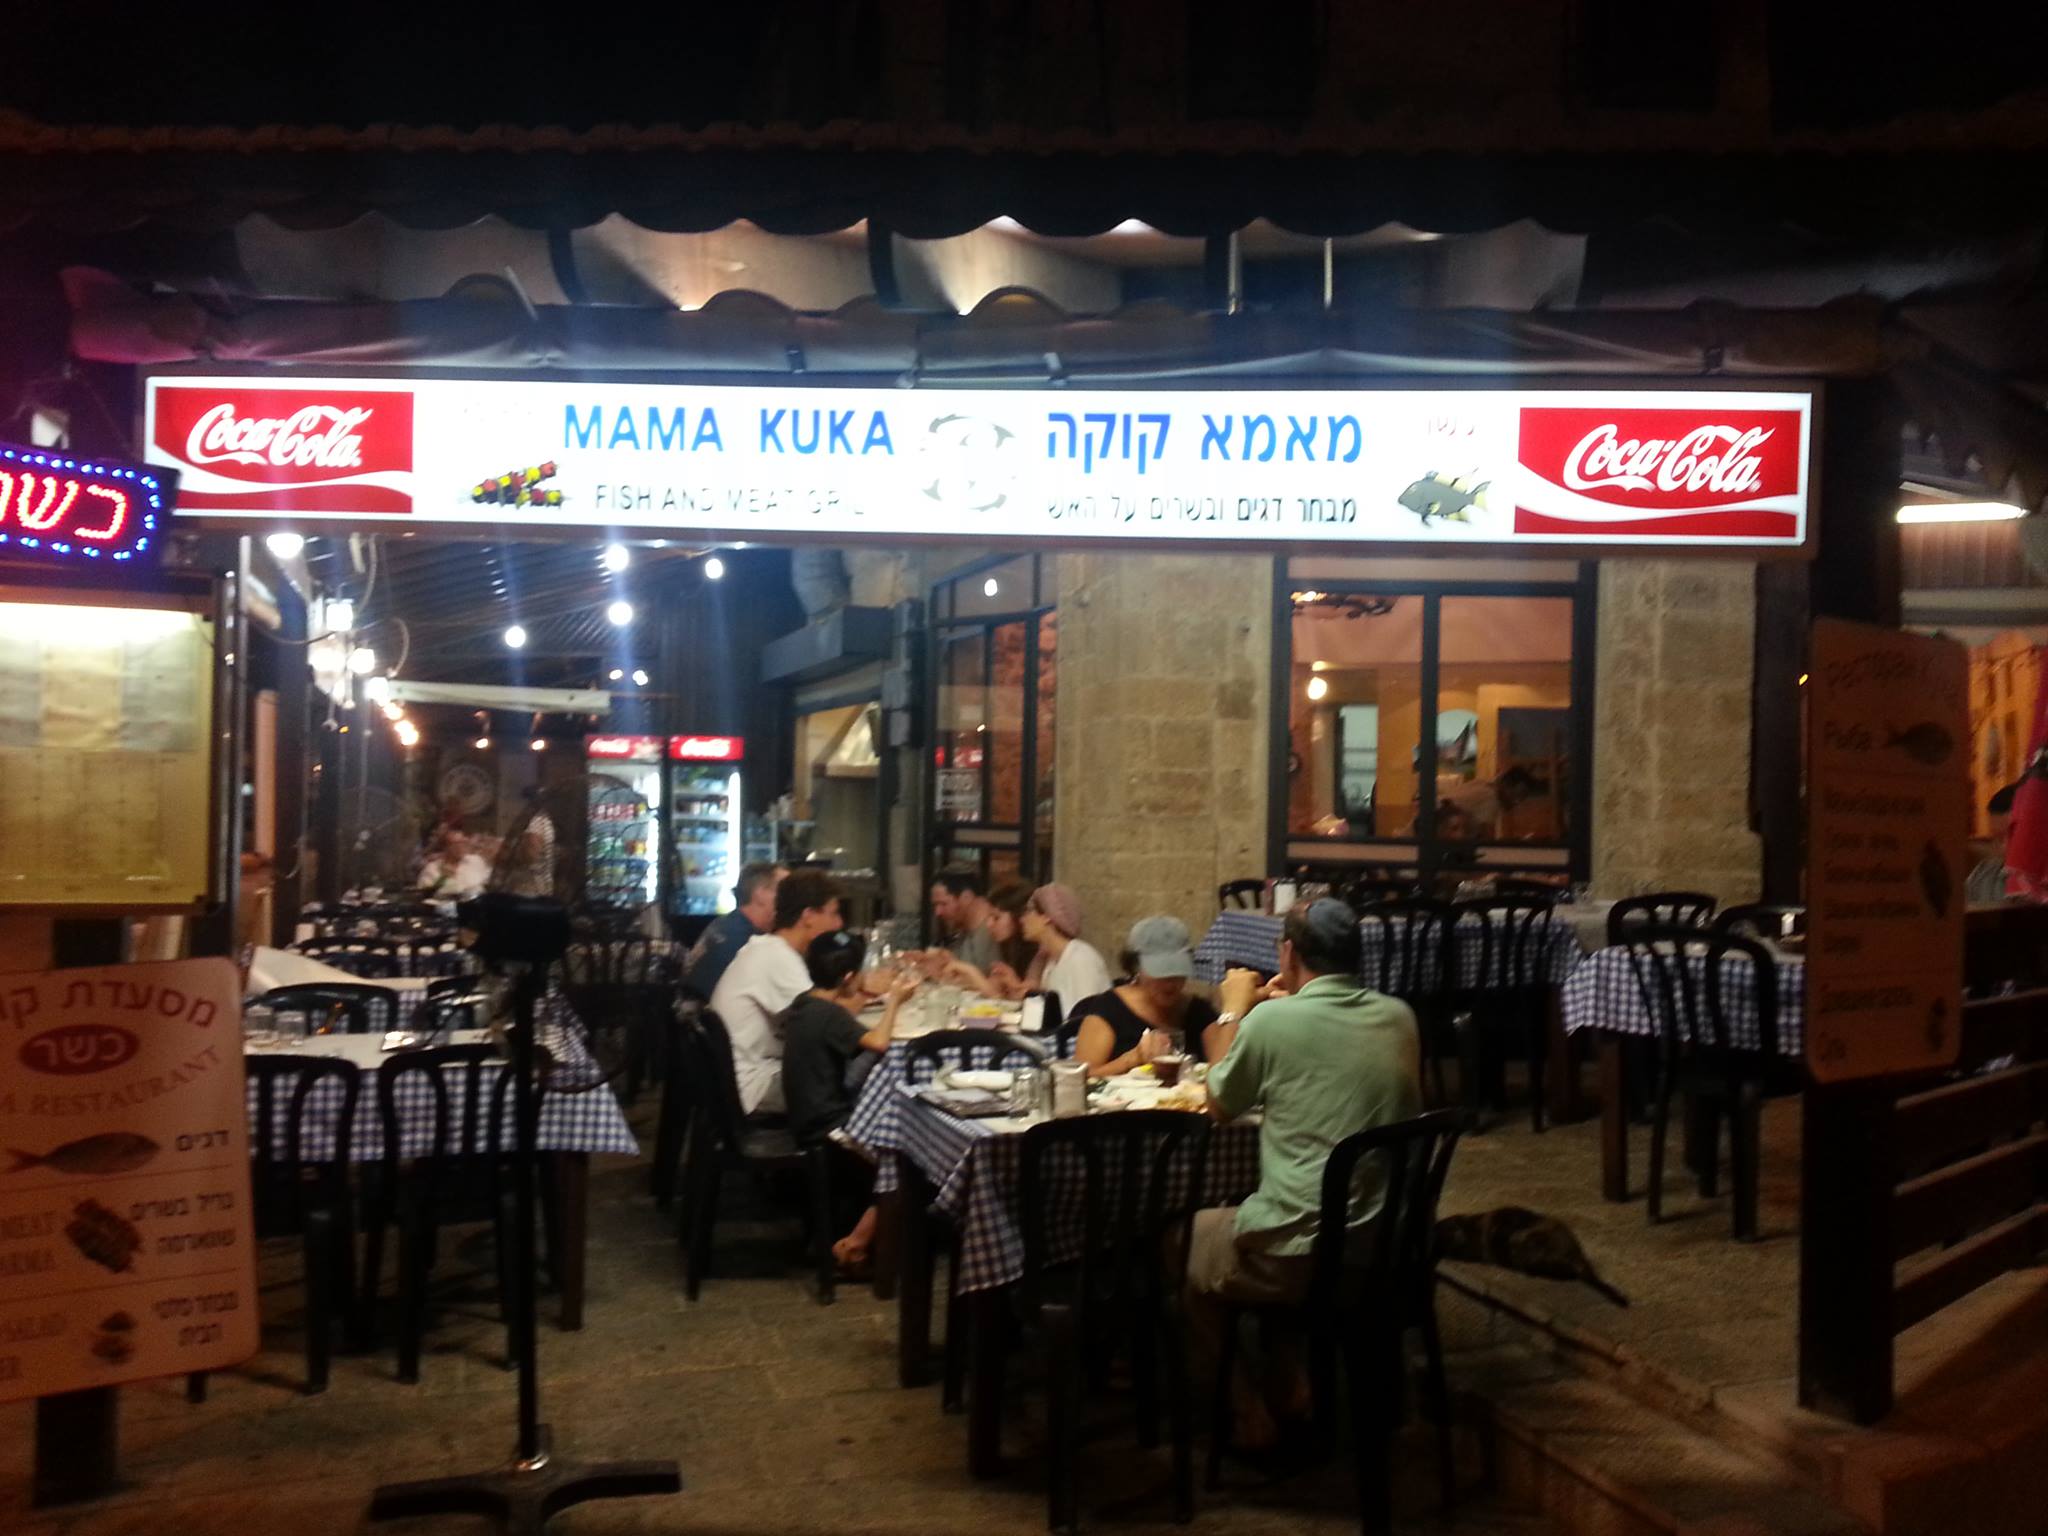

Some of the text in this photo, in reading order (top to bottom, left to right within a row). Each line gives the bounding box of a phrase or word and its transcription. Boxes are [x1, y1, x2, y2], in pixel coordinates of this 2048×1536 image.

[185, 403, 374, 470] Coca-Cola
[563, 404, 724, 452] MAMA
[759, 408, 896, 456] KUKA
[1046, 412, 1363, 475] מאמא קוקה
[1562, 423, 1777, 493] Coca-Cola
[595, 484, 652, 511] FISH
[1237, 496, 1284, 523] דגים
[1296, 496, 1358, 524] מבחר
[62, 979, 219, 1029] מסעדת
[31, 1031, 129, 1068] כשר
[30, 1043, 222, 1117] RESTAURANT
